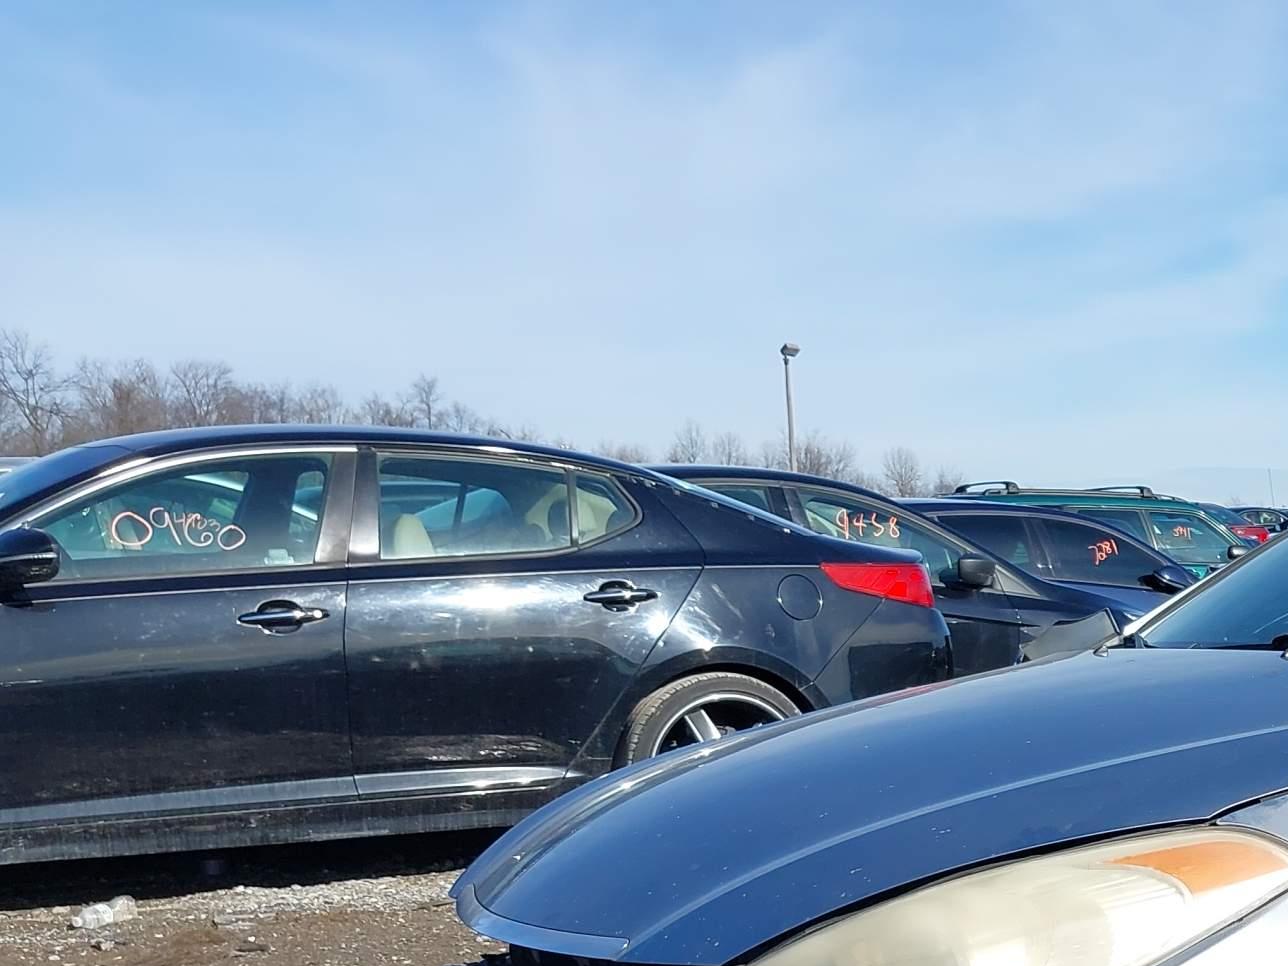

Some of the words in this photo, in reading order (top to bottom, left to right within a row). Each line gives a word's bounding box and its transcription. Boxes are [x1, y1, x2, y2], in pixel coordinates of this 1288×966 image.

[111, 507, 246, 551] 0960
[836, 508, 900, 540] 9458
[1087, 538, 1119, 566] 7281
